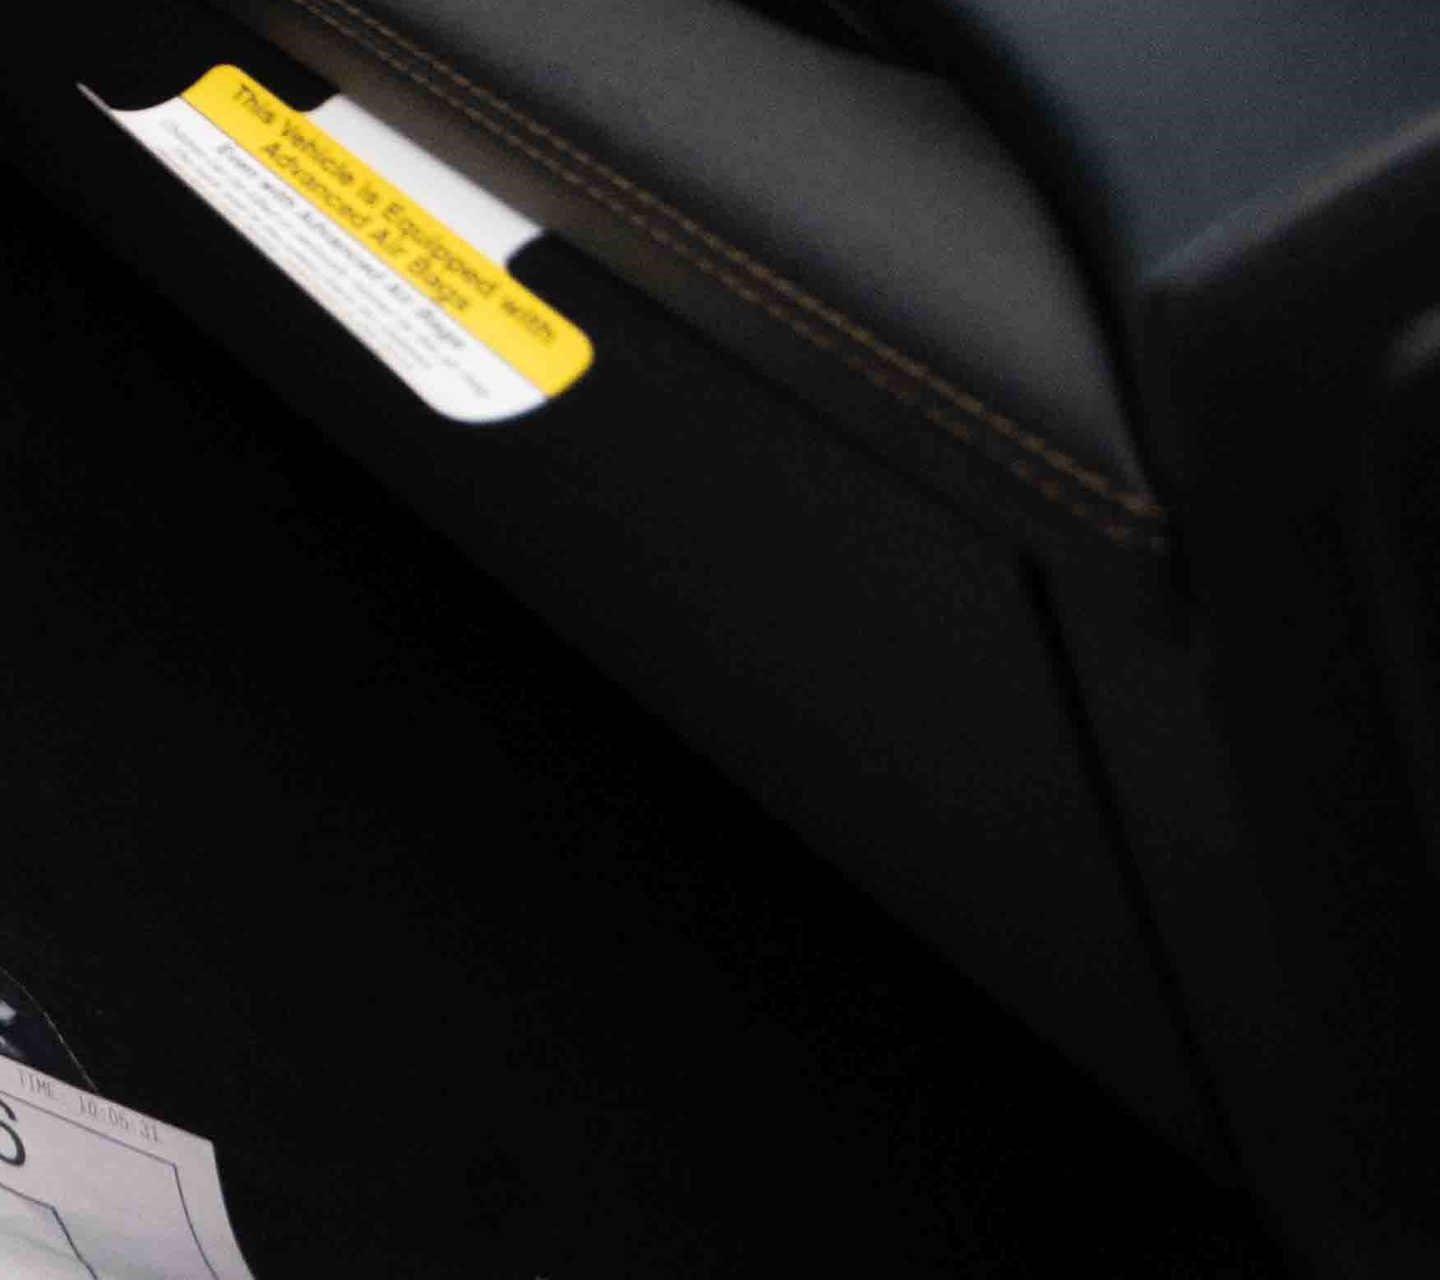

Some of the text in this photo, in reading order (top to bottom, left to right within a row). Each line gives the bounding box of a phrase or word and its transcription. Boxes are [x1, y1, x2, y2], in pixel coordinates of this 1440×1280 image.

[234, 85, 559, 346] This Vehicle is Equipped with
[261, 138, 474, 316] Advanced Air Bags
